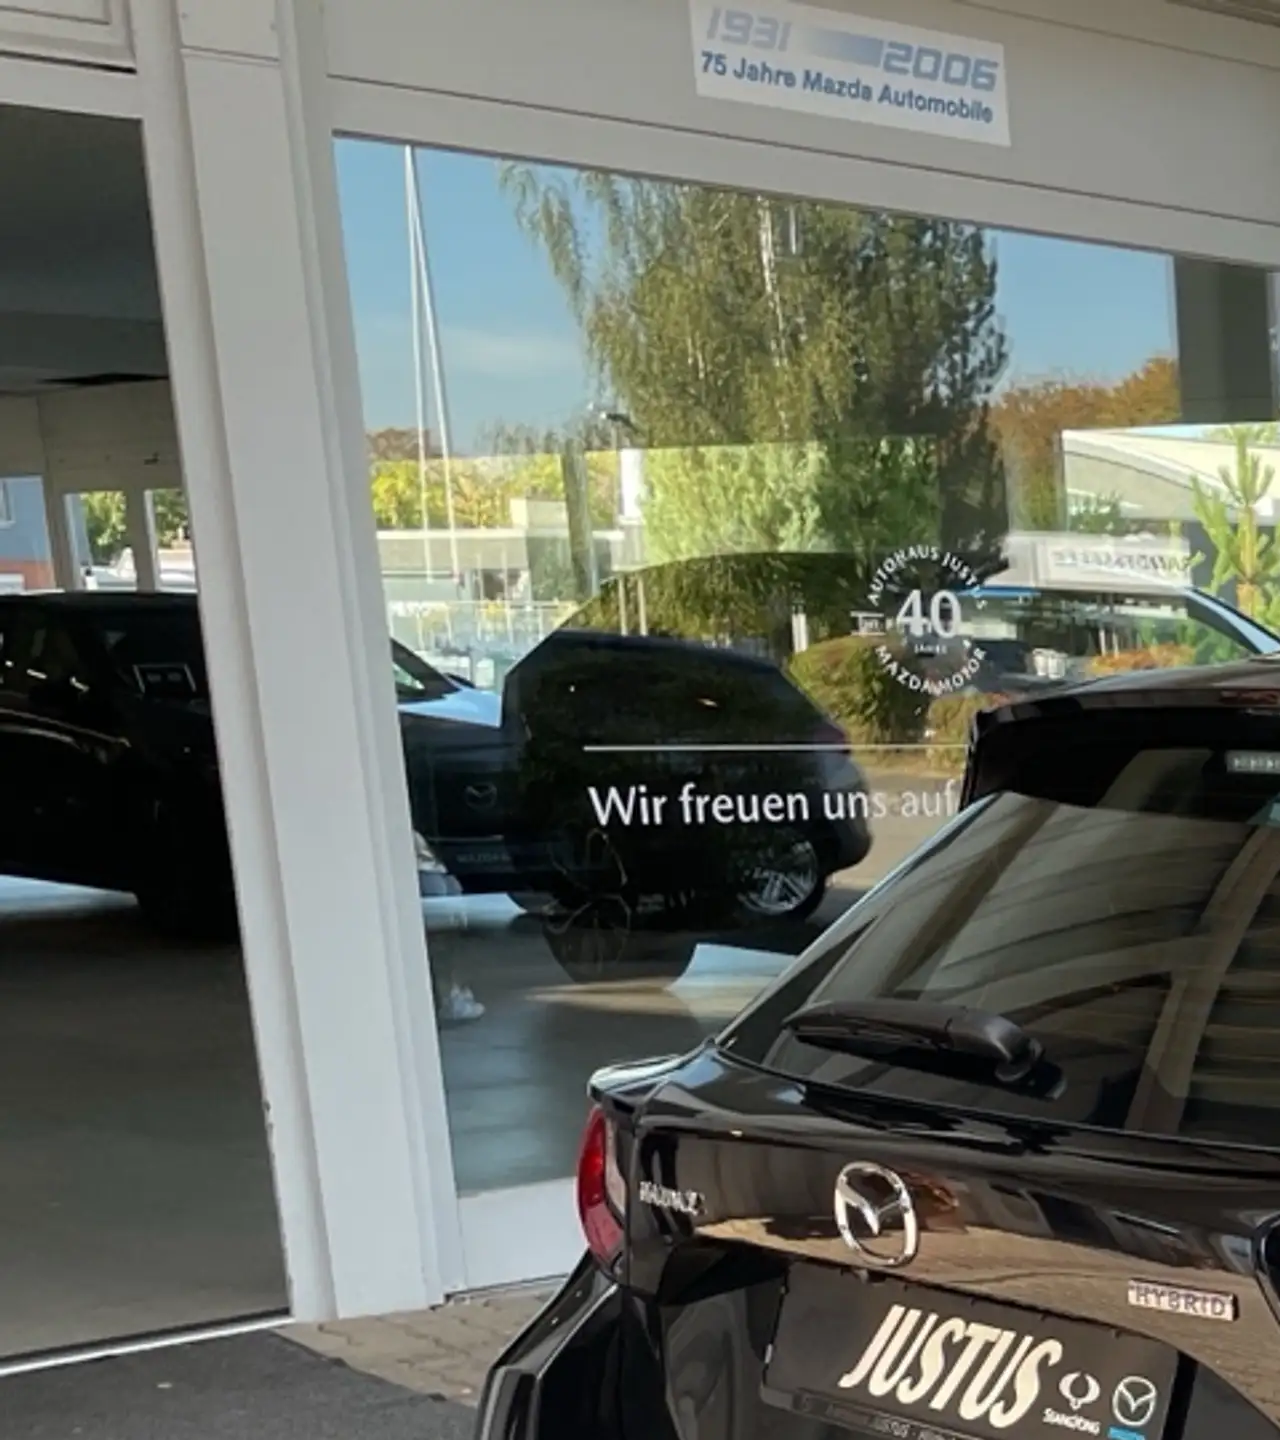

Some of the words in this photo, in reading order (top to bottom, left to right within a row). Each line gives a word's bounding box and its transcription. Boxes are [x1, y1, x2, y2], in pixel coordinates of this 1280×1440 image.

[706, 7, 790, 52] 1931
[883, 41, 999, 92] 2006
[700, 51, 727, 77] 75
[733, 57, 796, 88] Jahre
[802, 70, 872, 101] Mazda
[878, 85, 993, 123] Automobile
[867, 544, 940, 607] AUTOHAUS
[941, 552, 988, 610] JUSTUS
[896, 589, 962, 639] 40
[588, 785, 668, 827] Wir
[677, 782, 809, 824] freuen
[823, 787, 888, 819] uns
[898, 778, 958, 818] auf
[1136, 1285, 1226, 1316] HYBRID
[838, 1303, 1062, 1428] JUSTUS
